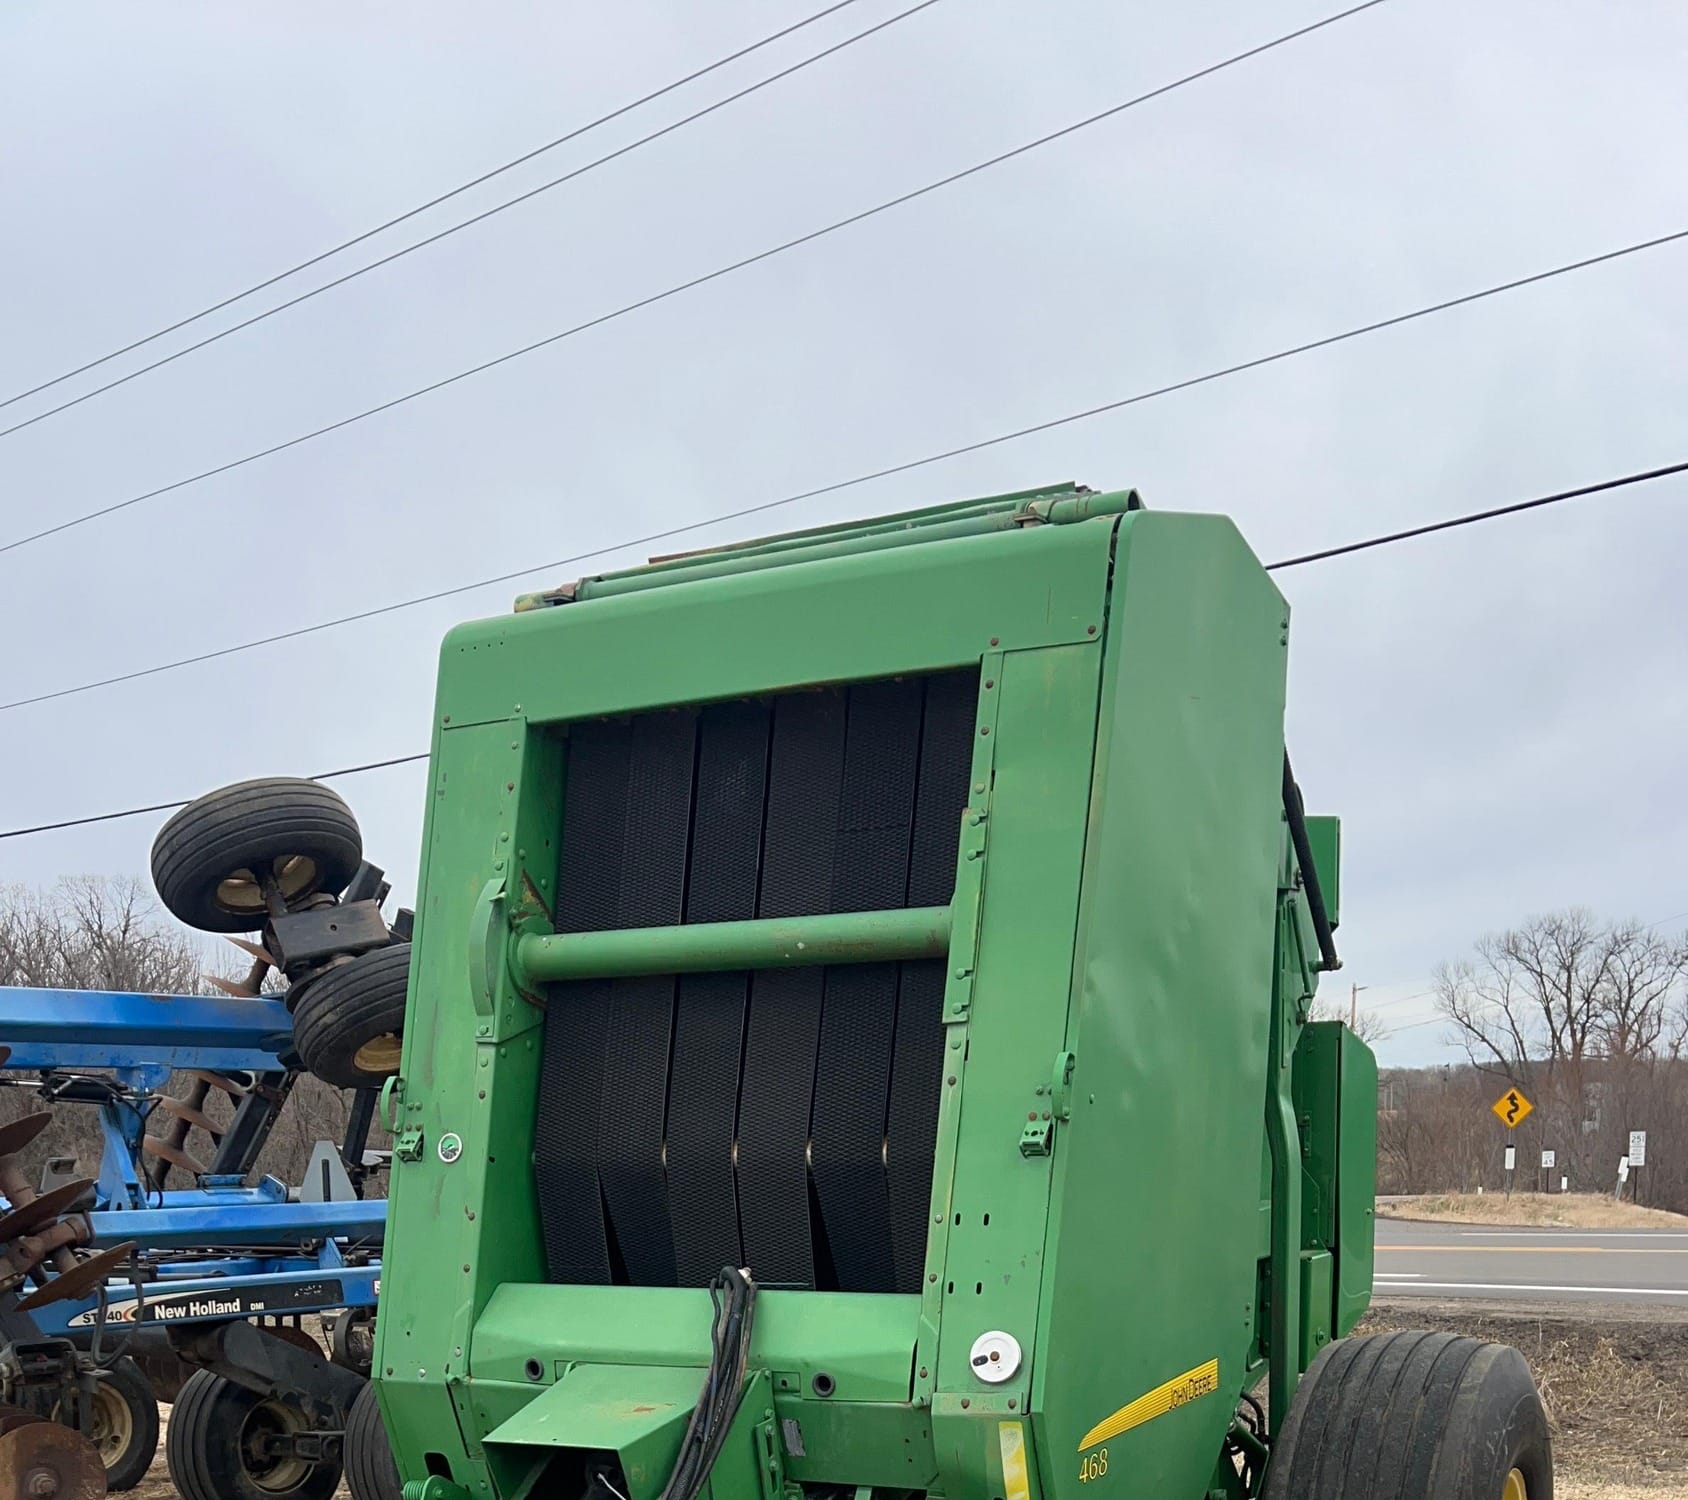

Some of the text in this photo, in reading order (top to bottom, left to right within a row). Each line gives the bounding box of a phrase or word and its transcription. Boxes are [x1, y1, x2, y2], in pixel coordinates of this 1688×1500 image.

[82, 1310, 122, 1324] ST40
[154, 1298, 241, 1320] New Holland
[250, 1302, 265, 1311] DMI
[1168, 1374, 1212, 1410] JOHN DEERE
[1079, 1447, 1108, 1483] 468
